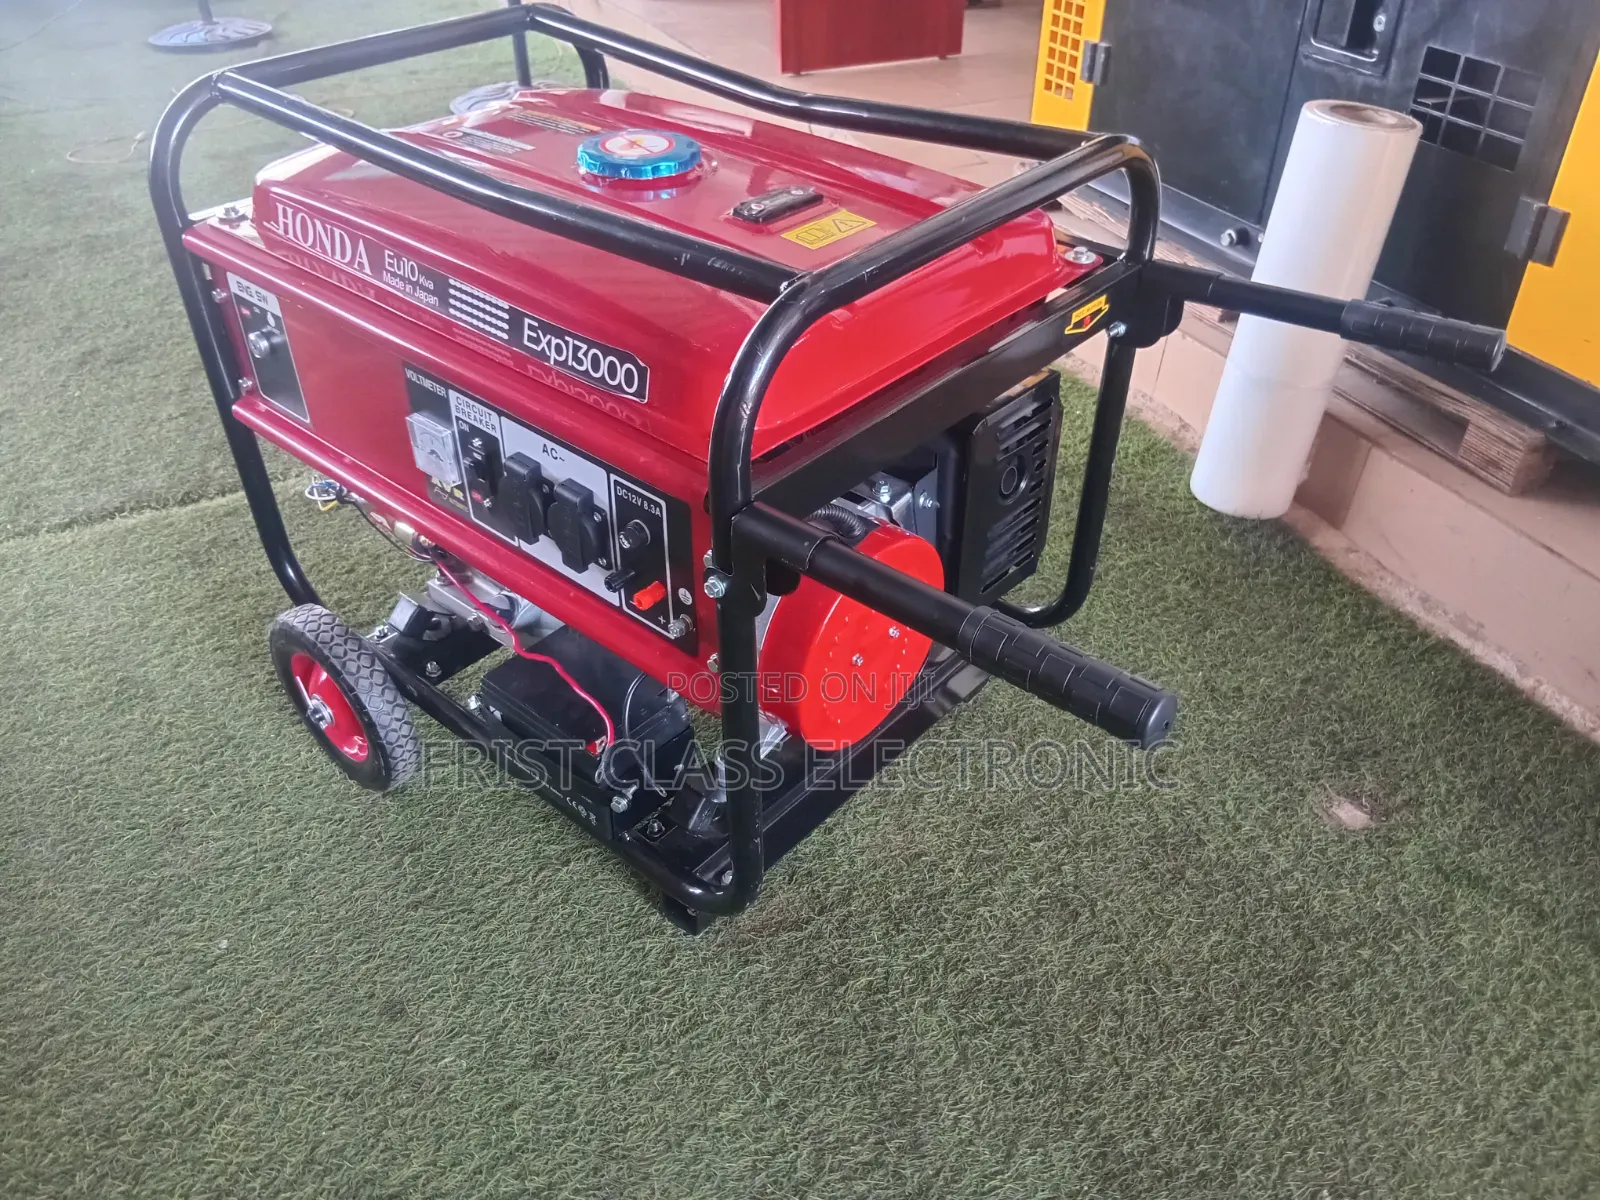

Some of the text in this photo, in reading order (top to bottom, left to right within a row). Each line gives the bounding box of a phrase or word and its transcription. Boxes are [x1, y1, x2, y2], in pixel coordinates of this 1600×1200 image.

[273, 202, 373, 276] HONDA
[384, 249, 434, 290] Eu10 Kva
[382, 270, 439, 307] Made in Japan
[522, 317, 639, 394] Exp13000
[404, 367, 448, 399] VOLTMETER
[455, 404, 498, 434] BREAKER
[456, 396, 493, 421] CIRCUIT
[458, 420, 470, 433] ON
[616, 485, 662, 518] DC12V 8.3A
